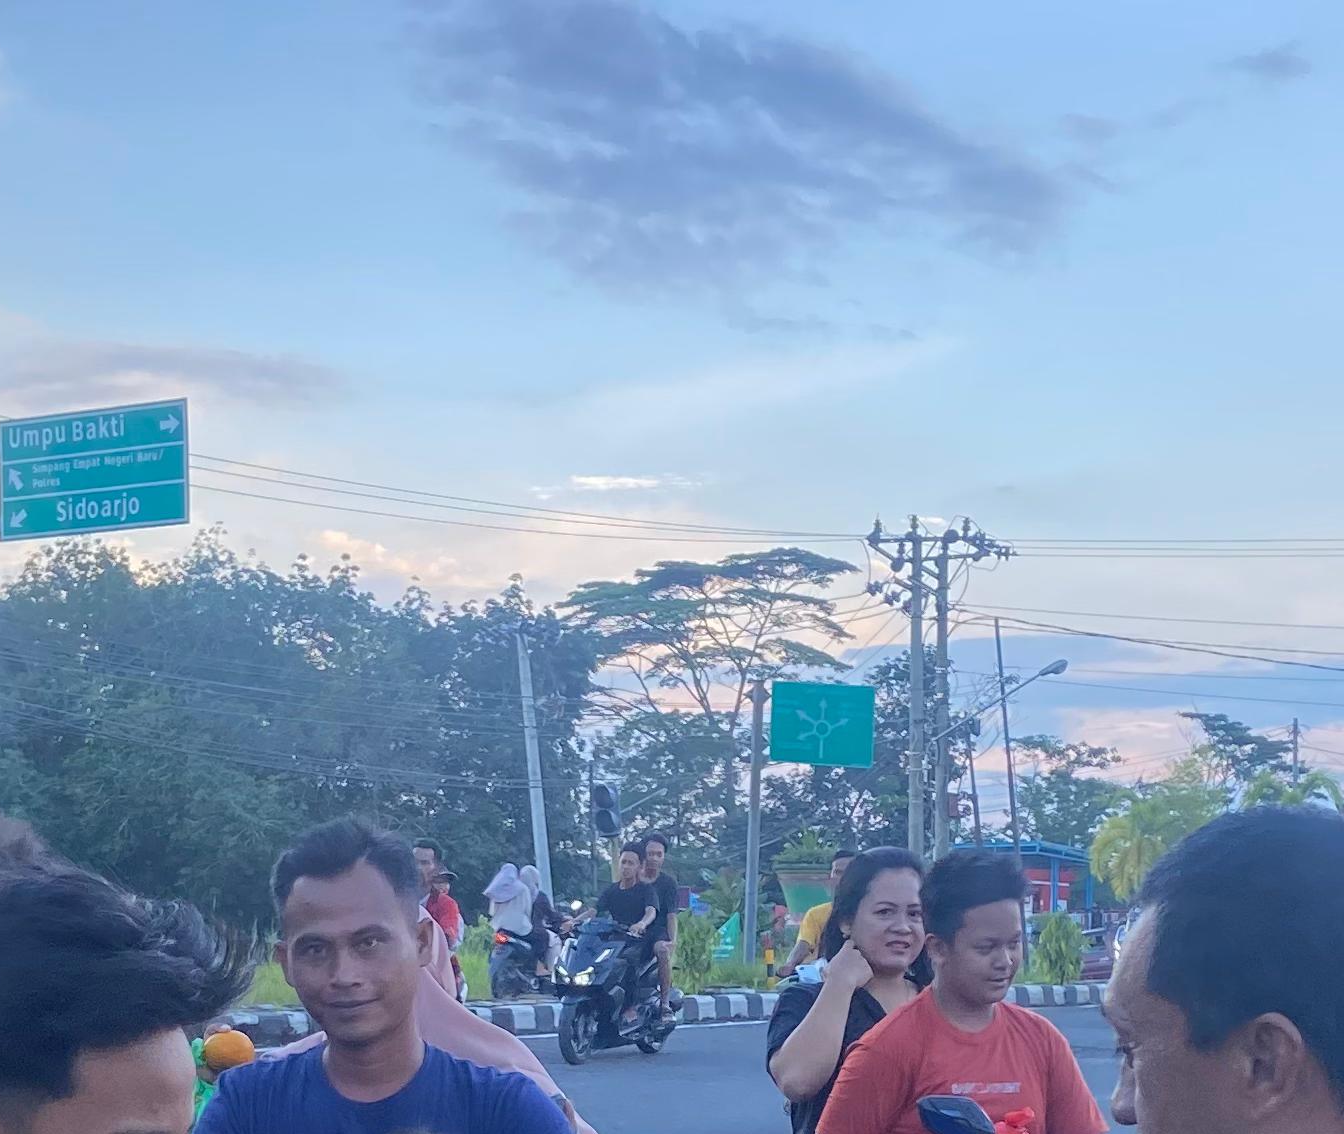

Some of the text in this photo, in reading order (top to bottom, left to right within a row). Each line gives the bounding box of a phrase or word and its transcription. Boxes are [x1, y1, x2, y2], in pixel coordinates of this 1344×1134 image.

[9, 414, 125, 450] Umpu Bakti
[32, 462, 71, 474] Simpang
[73, 457, 100, 470] Empat
[57, 492, 140, 521] Sidoarjo
